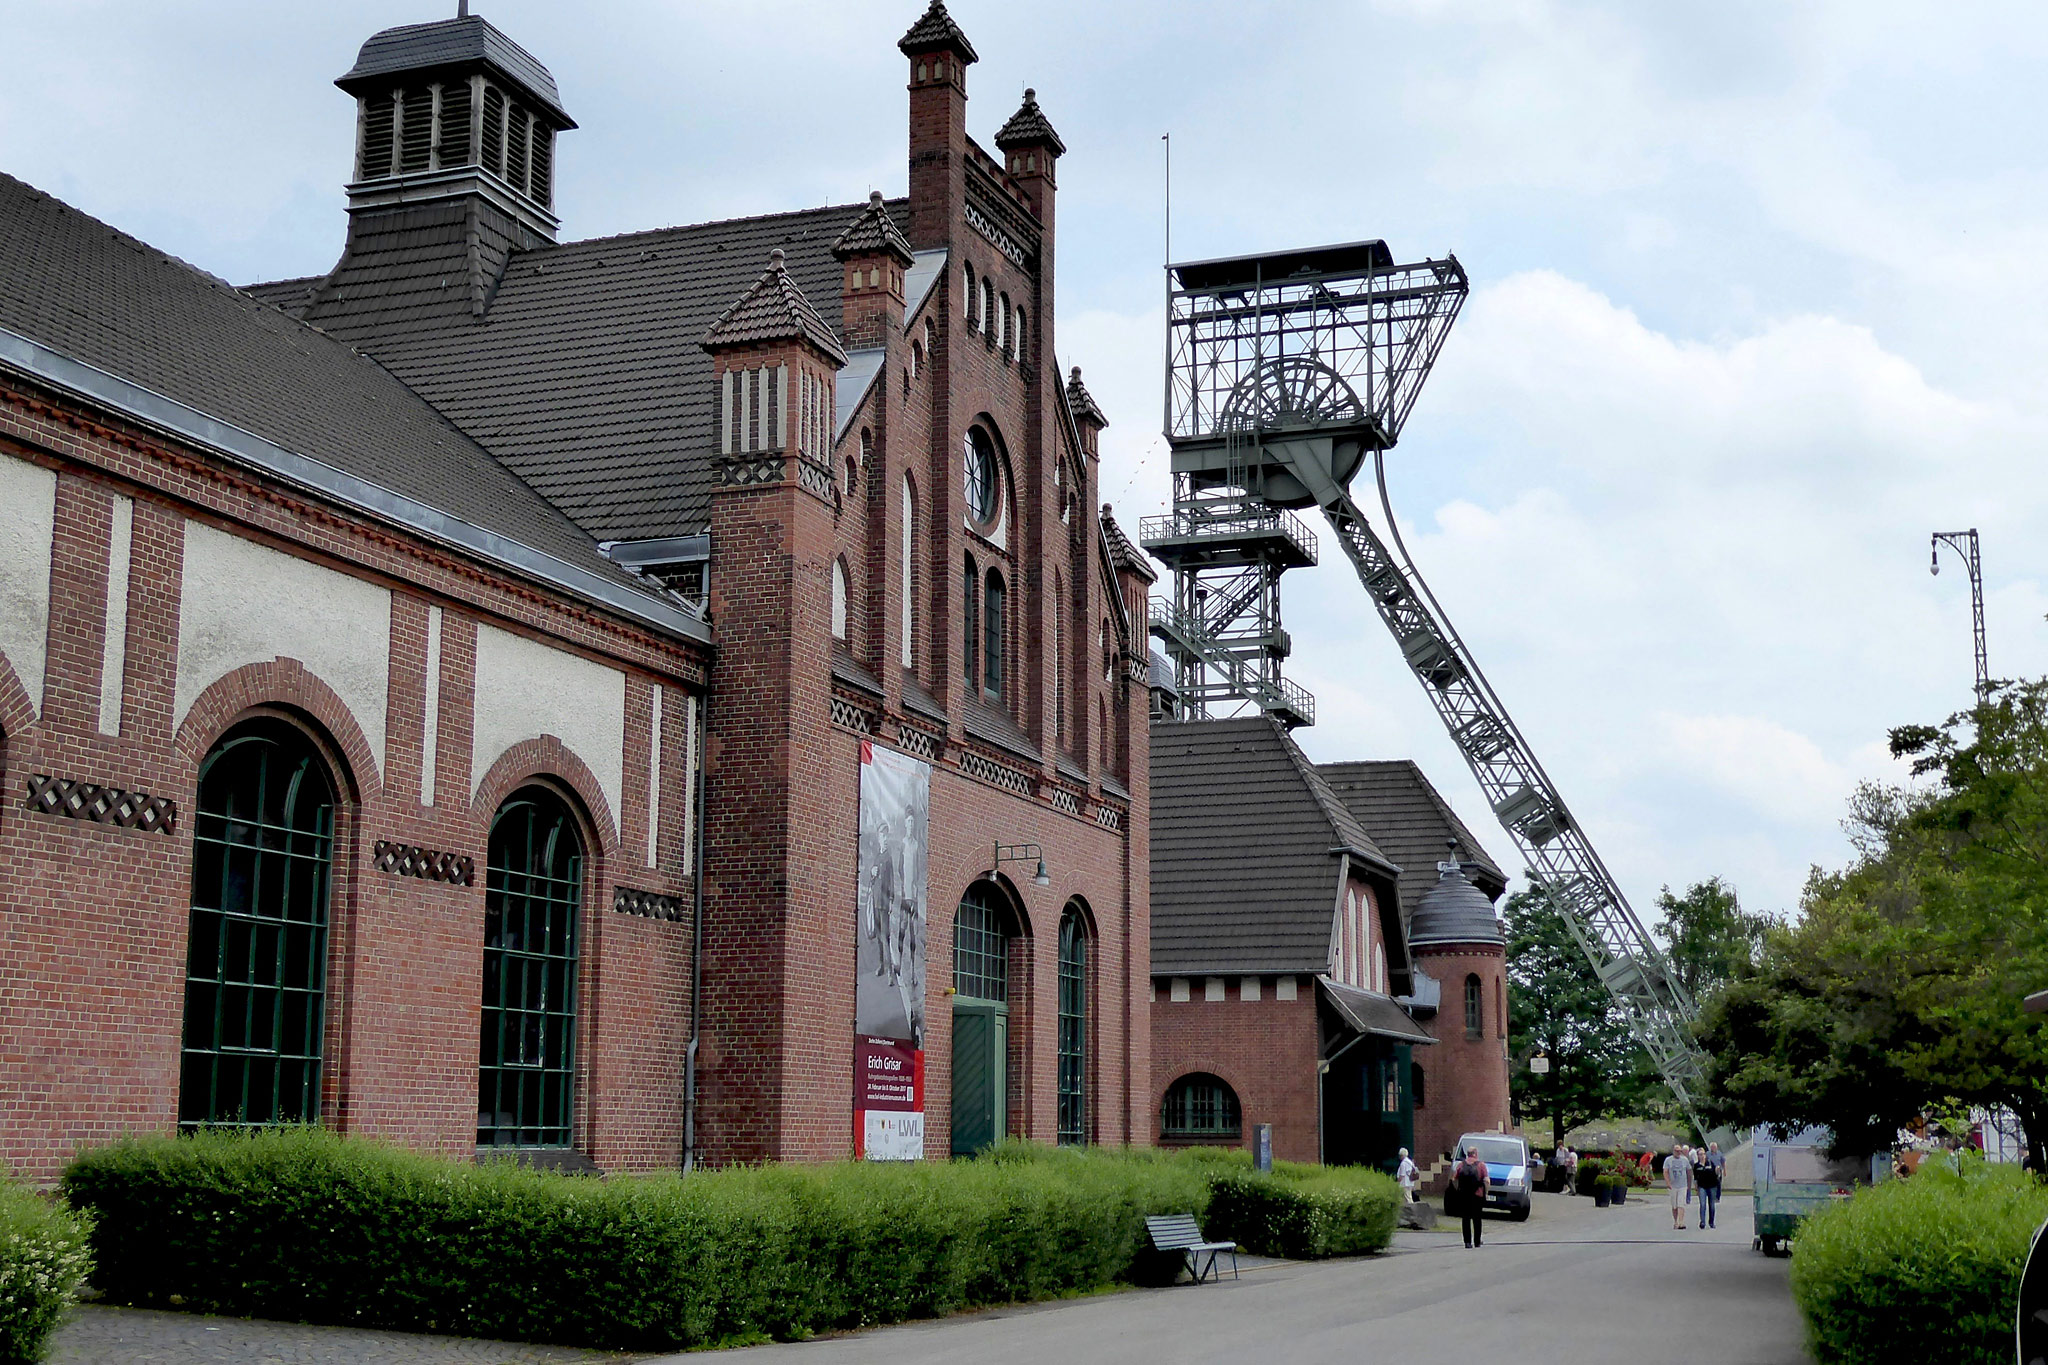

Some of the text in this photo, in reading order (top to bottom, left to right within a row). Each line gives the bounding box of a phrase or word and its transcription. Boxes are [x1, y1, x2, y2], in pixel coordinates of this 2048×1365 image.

[868, 1055, 902, 1071] Erich Grisar
[898, 1120, 920, 1137] LWL
